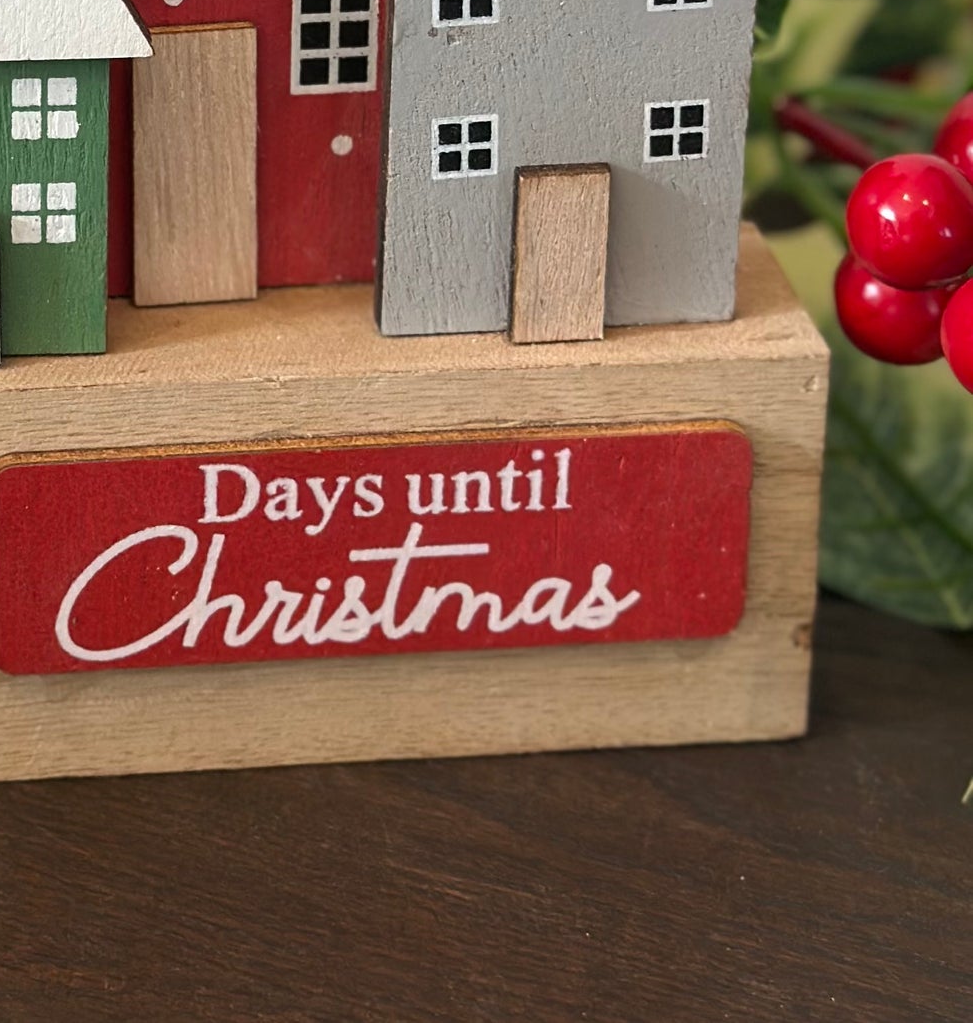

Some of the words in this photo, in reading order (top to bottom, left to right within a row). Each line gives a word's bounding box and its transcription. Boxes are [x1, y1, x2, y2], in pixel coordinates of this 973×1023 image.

[197, 463, 385, 536] Days
[404, 447, 572, 515] until
[54, 522, 641, 662] Christmas
